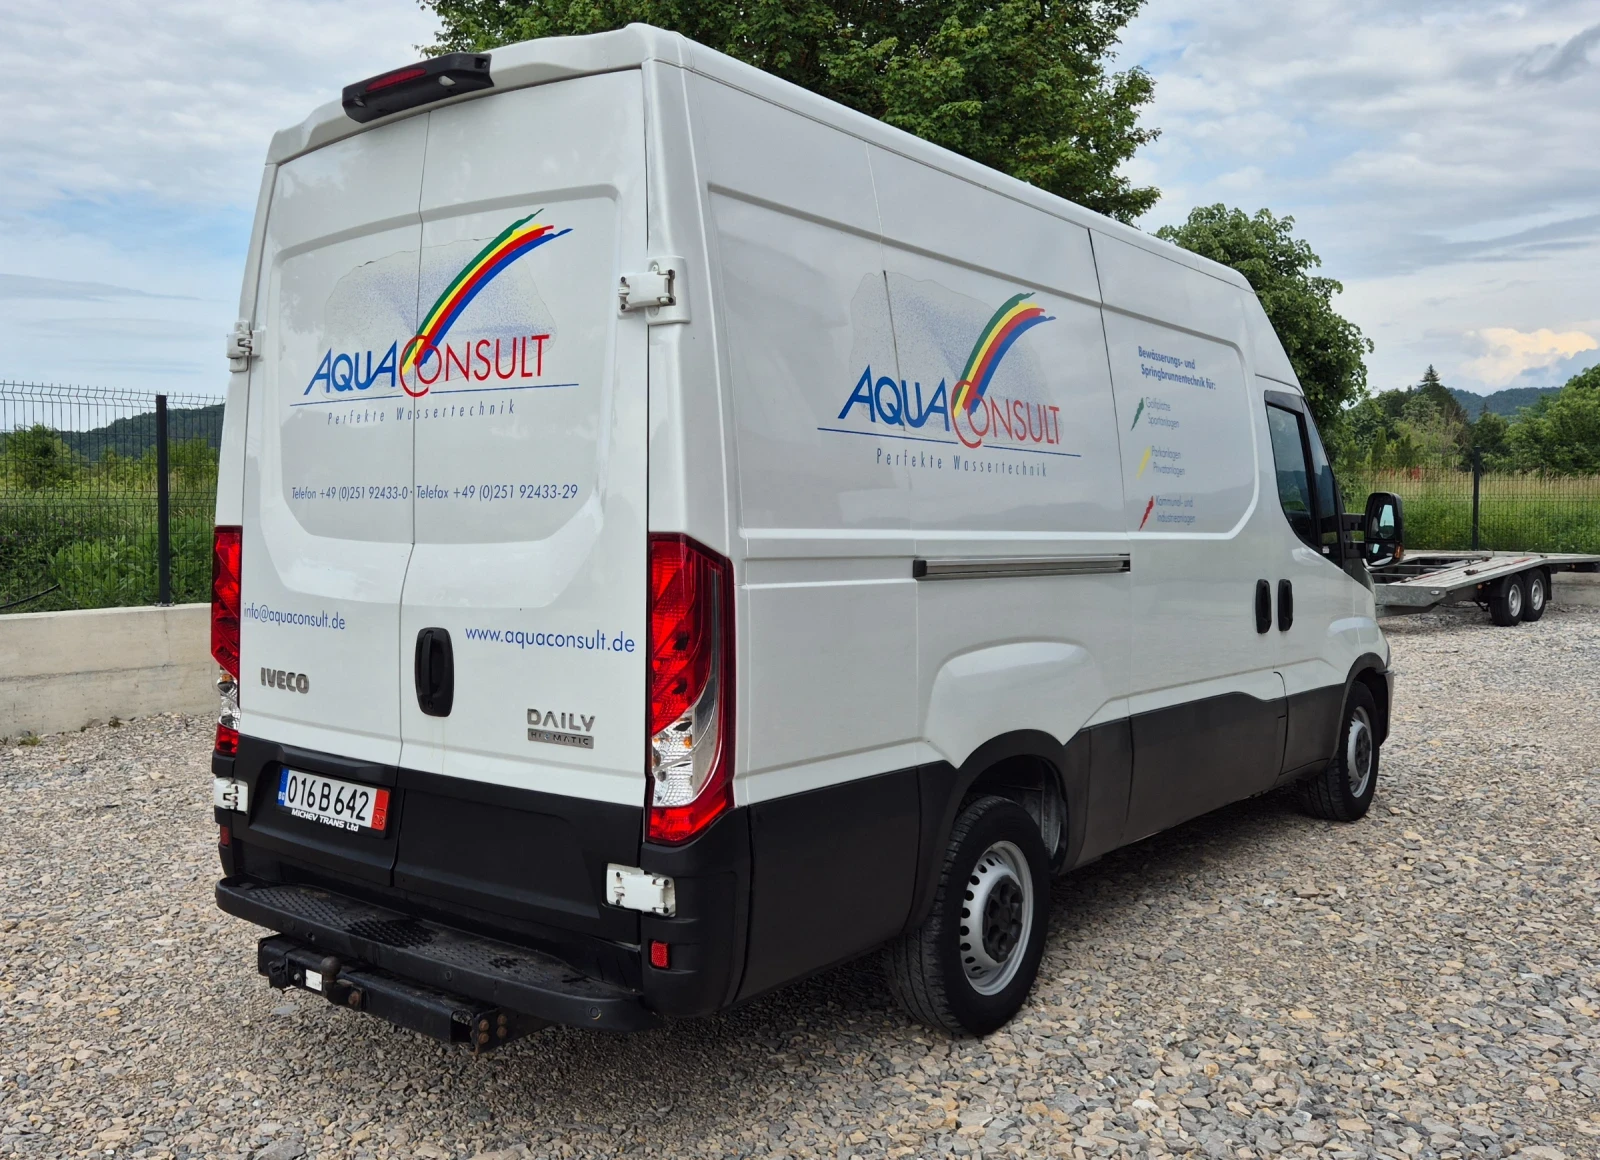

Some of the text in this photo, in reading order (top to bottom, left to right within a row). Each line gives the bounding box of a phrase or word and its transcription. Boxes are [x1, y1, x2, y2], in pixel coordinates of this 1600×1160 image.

[1138, 345, 1195, 370] Bewässerungs- und
[1141, 363, 1205, 388] Springbrunnentechnik
[328, 399, 515, 426] Perfekte Wassertechnik
[877, 447, 1047, 477] Perfekte Wassertechnik
[292, 487, 317, 500] Telefon
[320, 487, 336, 499] +49
[338, 486, 365, 502] (0)251
[416, 484, 578, 502] Telefax +49 (0)251 92433-29
[243, 603, 346, 630] info@aquaconsult.de
[465, 627, 636, 652] www.aquaconsult.de
[260, 667, 310, 694] IVECO
[527, 708, 595, 732] DAILY
[278, 791, 285, 801] BG
[291, 808, 359, 832] MICHEV TRANS Ltd
